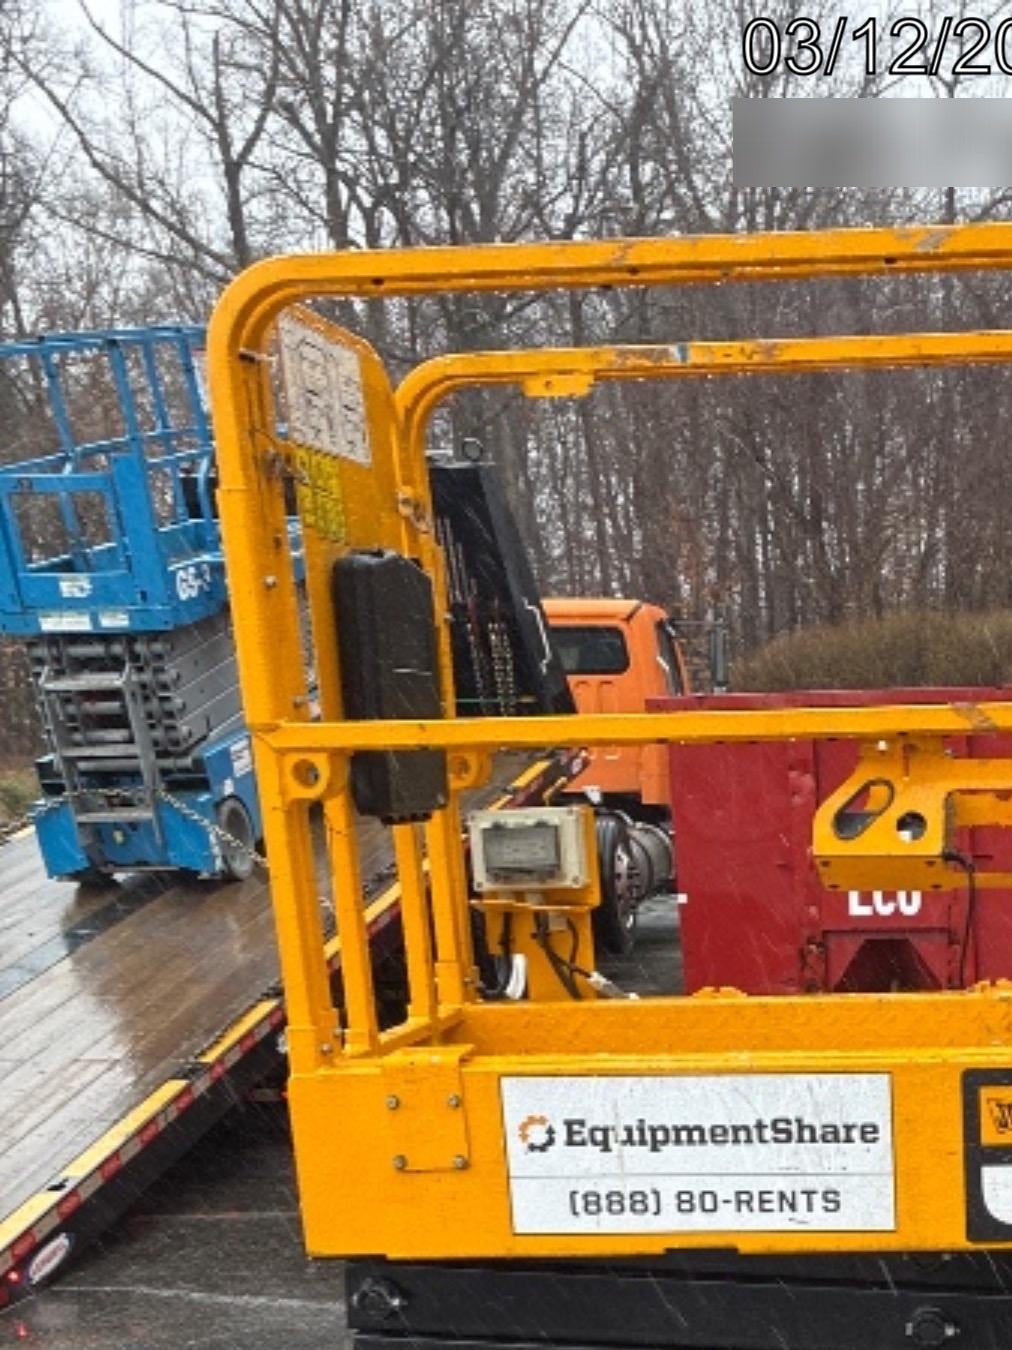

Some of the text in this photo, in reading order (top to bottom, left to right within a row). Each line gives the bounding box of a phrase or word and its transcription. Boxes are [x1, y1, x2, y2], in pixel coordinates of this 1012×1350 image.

[563, 1116, 880, 1152] EquipmentShare
[569, 1189, 842, 1216] (888) 80-RENTS
